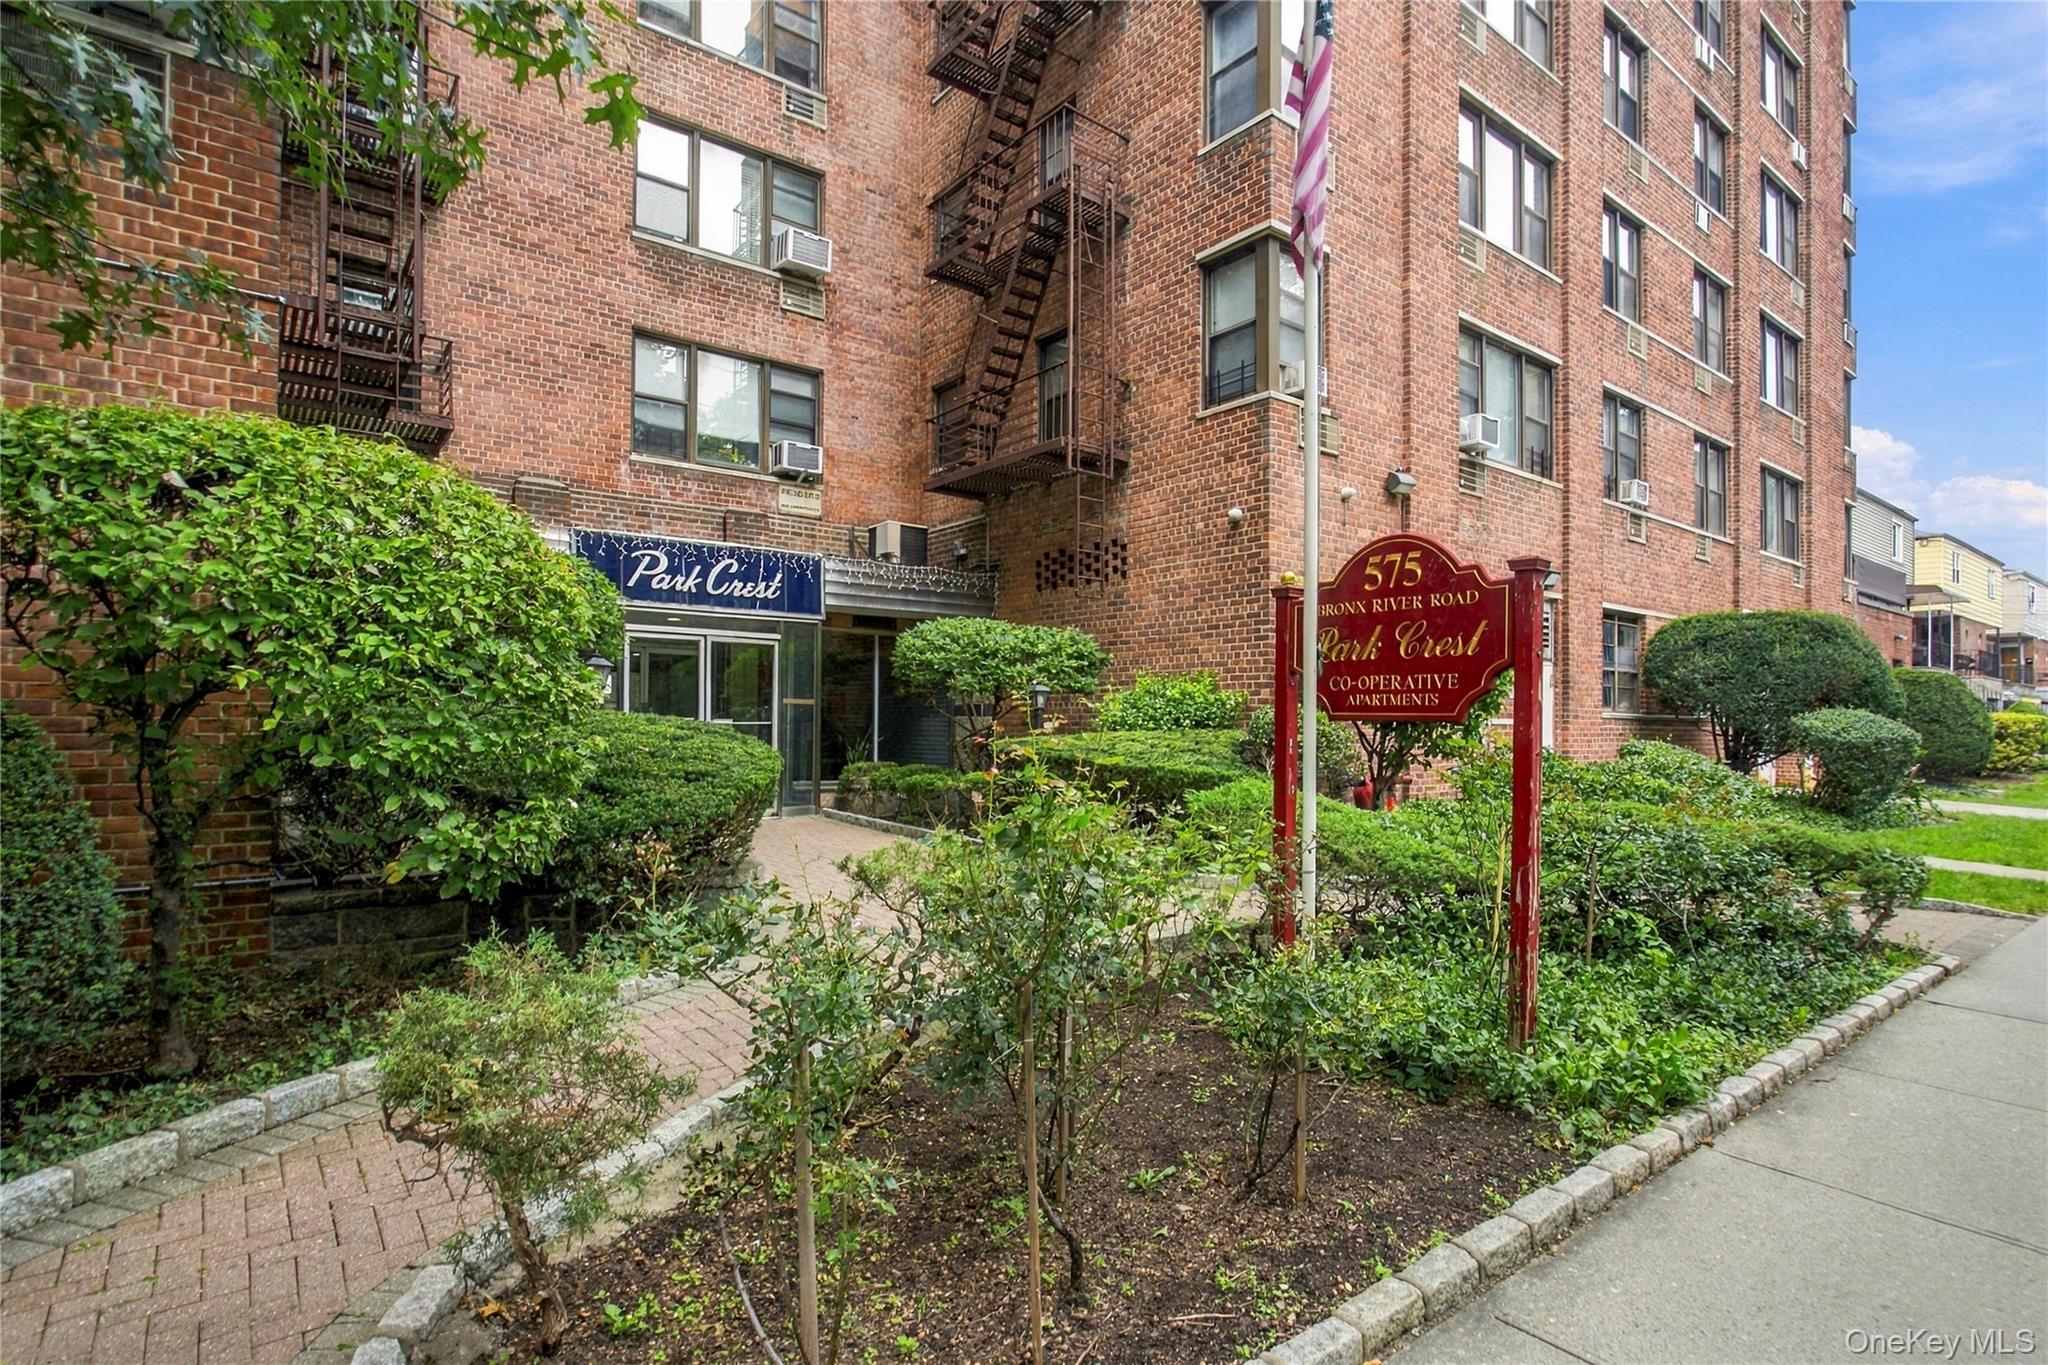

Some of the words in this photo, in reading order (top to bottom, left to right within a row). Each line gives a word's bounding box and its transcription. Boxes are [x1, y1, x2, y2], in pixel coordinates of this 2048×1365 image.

[626, 549, 703, 593] Park
[706, 558, 783, 599] Crest
[1364, 550, 1423, 592] 575
[1318, 600, 1367, 617] BRONX
[1372, 595, 1423, 613] RIVER
[1430, 590, 1480, 608] ROAD
[1318, 624, 1382, 664] Park
[1395, 619, 1489, 660] Crest
[1329, 673, 1459, 691] CO-OPERATIVE
[1345, 693, 1439, 707] APARTMENTS
